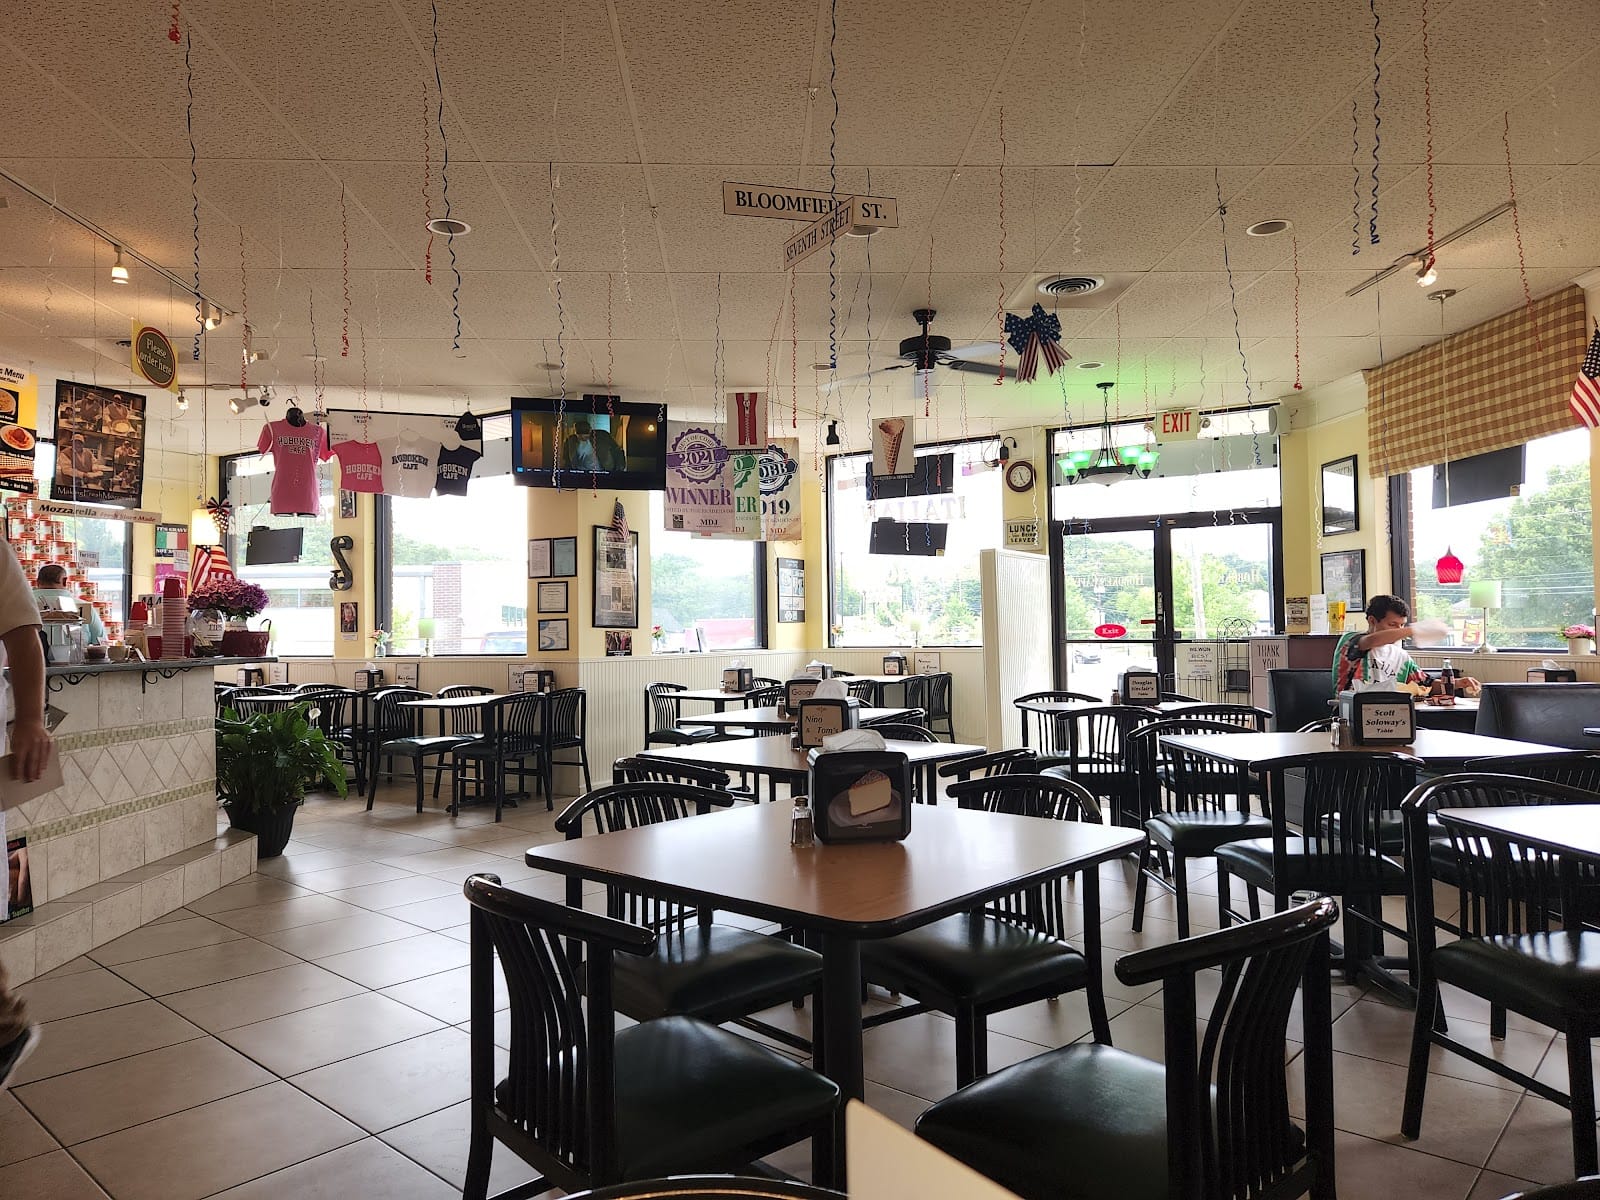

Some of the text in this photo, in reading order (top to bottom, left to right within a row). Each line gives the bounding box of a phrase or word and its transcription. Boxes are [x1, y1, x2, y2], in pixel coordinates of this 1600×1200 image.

[735, 190, 888, 220] BLOOMFIEL ST.
[786, 206, 851, 262] SEVENTH STREET
[146, 338, 167, 359] Please
[139, 352, 172, 376] order here
[1162, 411, 1192, 434] EXIT
[391, 454, 429, 467] HOBOKEN
[678, 449, 716, 466] 2021
[356, 472, 373, 480] CAFE
[442, 471, 458, 480] CAFE
[666, 487, 732, 506] WINNER
[39, 504, 97, 517] Mozzarella
[700, 518, 719, 526] MDJ
[1257, 644, 1280, 657] THANK
[1262, 658, 1277, 670] YOU
[805, 715, 823, 723] Nino
[1375, 709, 1396, 717] Scott
[1365, 718, 1406, 727] Soloway's
[817, 726, 839, 734] Tom's
